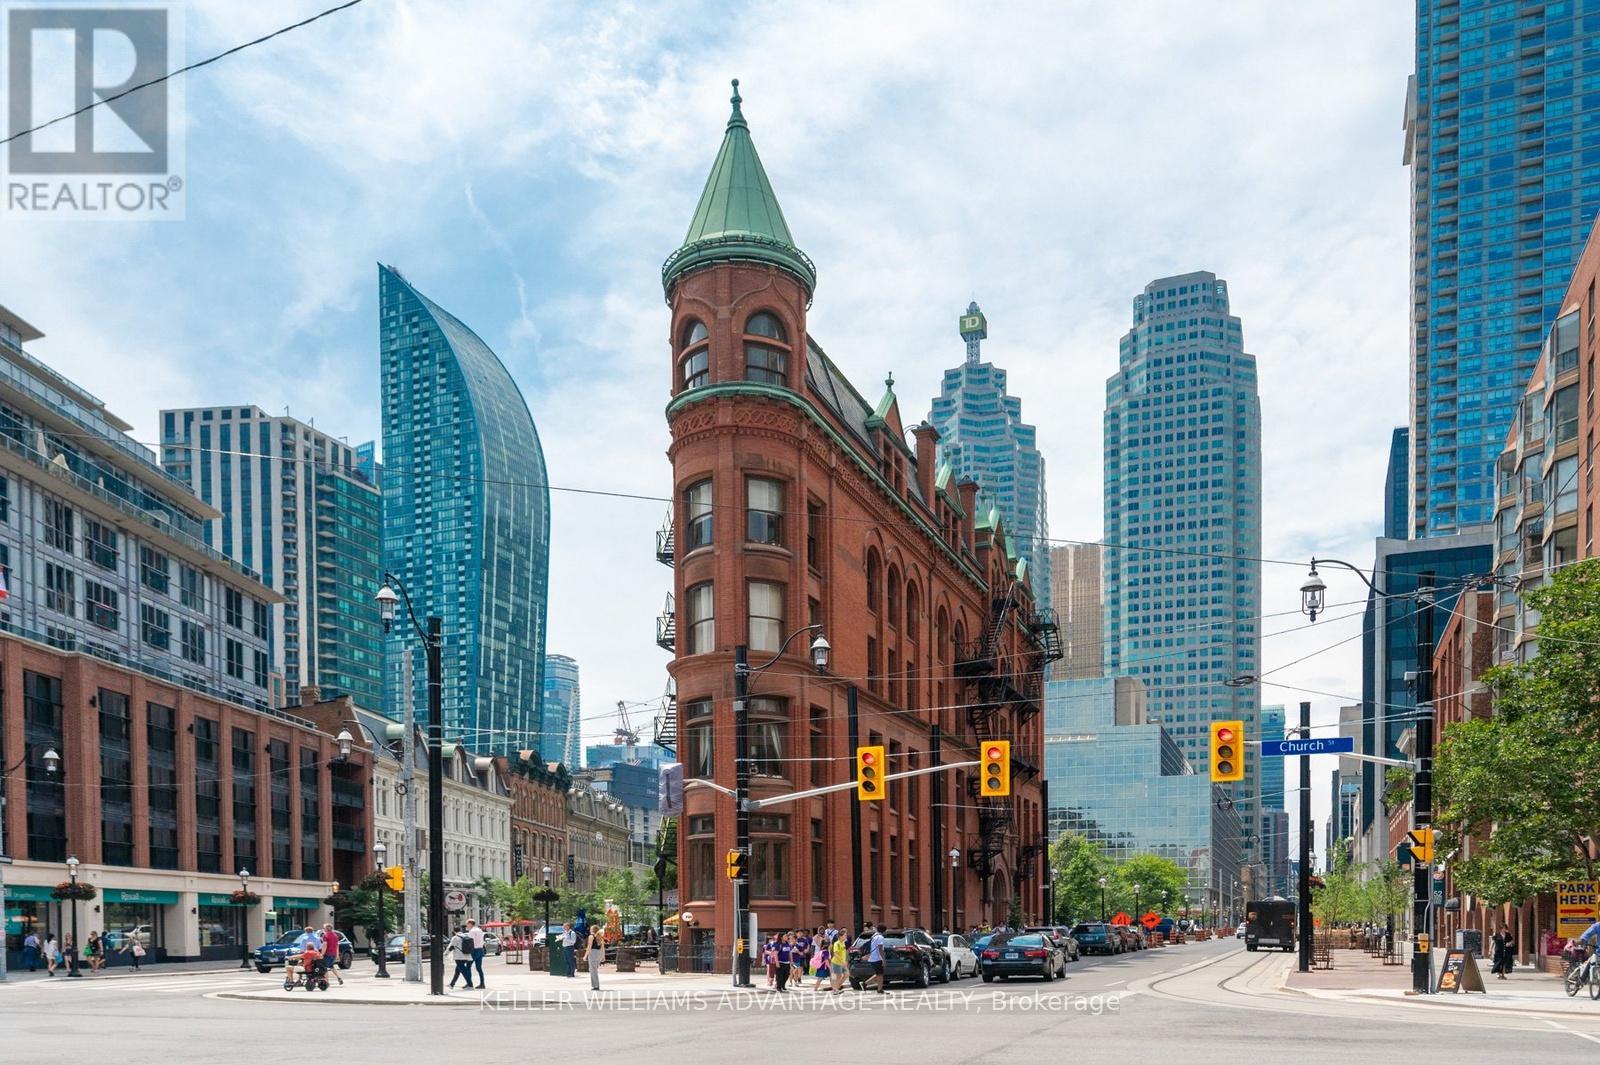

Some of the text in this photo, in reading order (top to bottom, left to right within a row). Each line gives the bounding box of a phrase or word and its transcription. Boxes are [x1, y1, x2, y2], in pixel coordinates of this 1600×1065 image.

[961, 316, 980, 329] TD
[1280, 740, 1324, 752] Church
[1560, 883, 1595, 893] PARK
[1560, 894, 1596, 905] HERE
